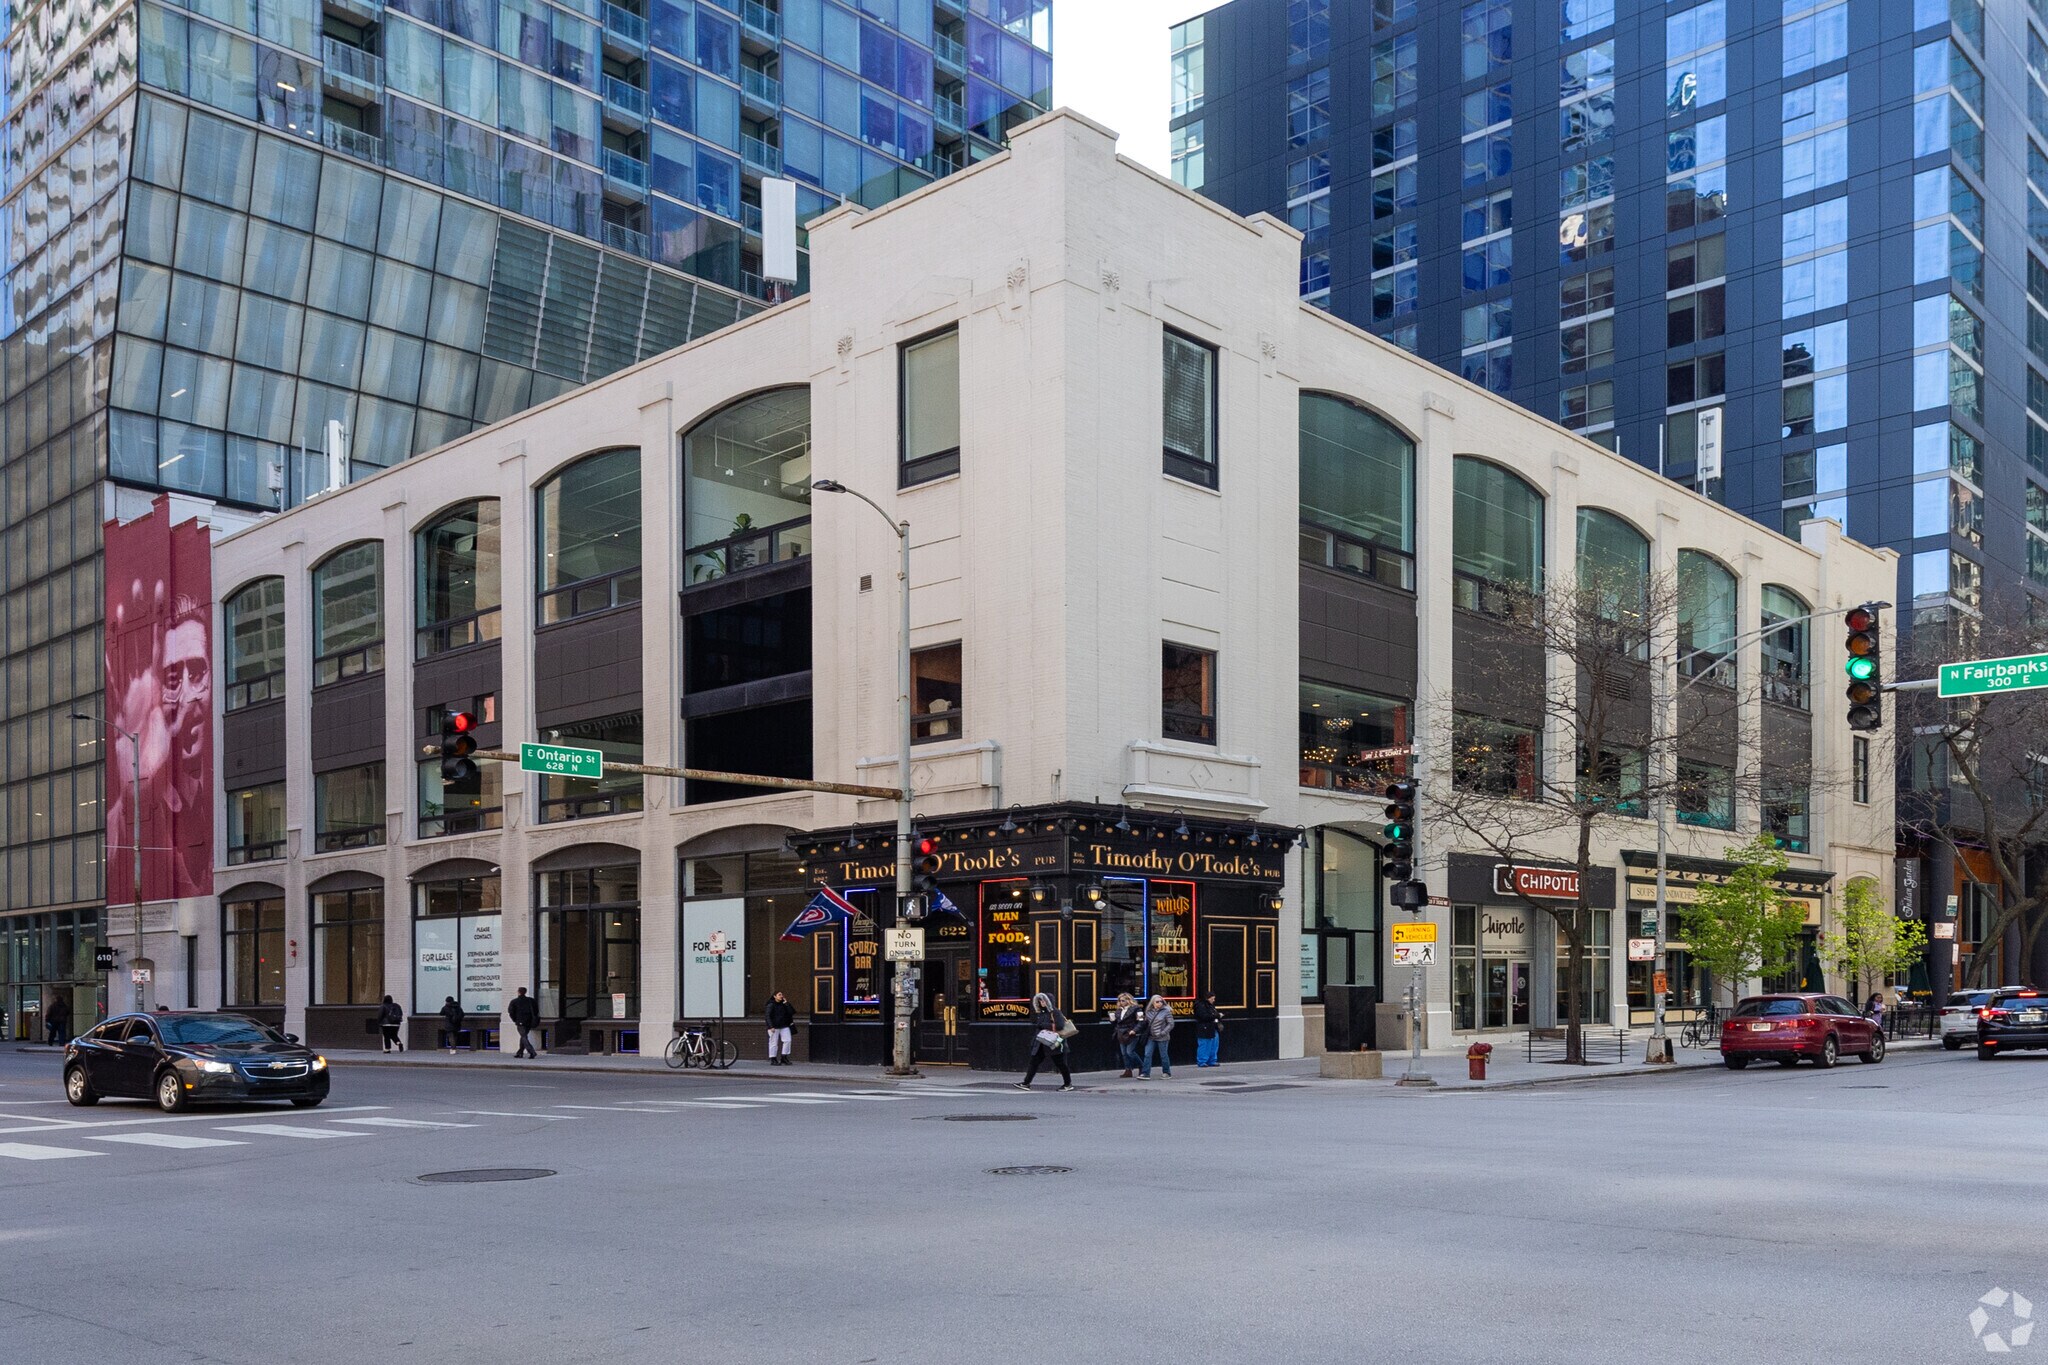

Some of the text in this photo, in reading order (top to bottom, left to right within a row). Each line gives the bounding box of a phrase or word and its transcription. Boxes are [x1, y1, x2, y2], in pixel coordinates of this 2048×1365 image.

[1951, 660, 2048, 680] N Fairbanks
[1987, 675, 2031, 688] 300 E
[527, 748, 595, 764] E Ontario St
[546, 762, 578, 772] 628 N
[1034, 855, 1056, 866] PUB
[1090, 844, 1281, 878] Timothy O'Toole's PUB
[1520, 873, 1579, 892] CHIPOTLE
[1636, 886, 1696, 901] SOUPS ANDWICHES
[993, 911, 1019, 922] MAN
[939, 925, 968, 936] 622
[988, 932, 1025, 943] FOOD
[692, 941, 710, 952] FOR
[848, 940, 879, 957] SPORTS
[1155, 937, 1190, 954] BEER
[422, 952, 454, 963] FOR LEASE
[695, 956, 715, 964] RETAIL
[854, 955, 872, 970] BAR
[982, 1003, 1030, 1016] FAMILY OWNED
[1173, 1008, 1195, 1016] INNER
